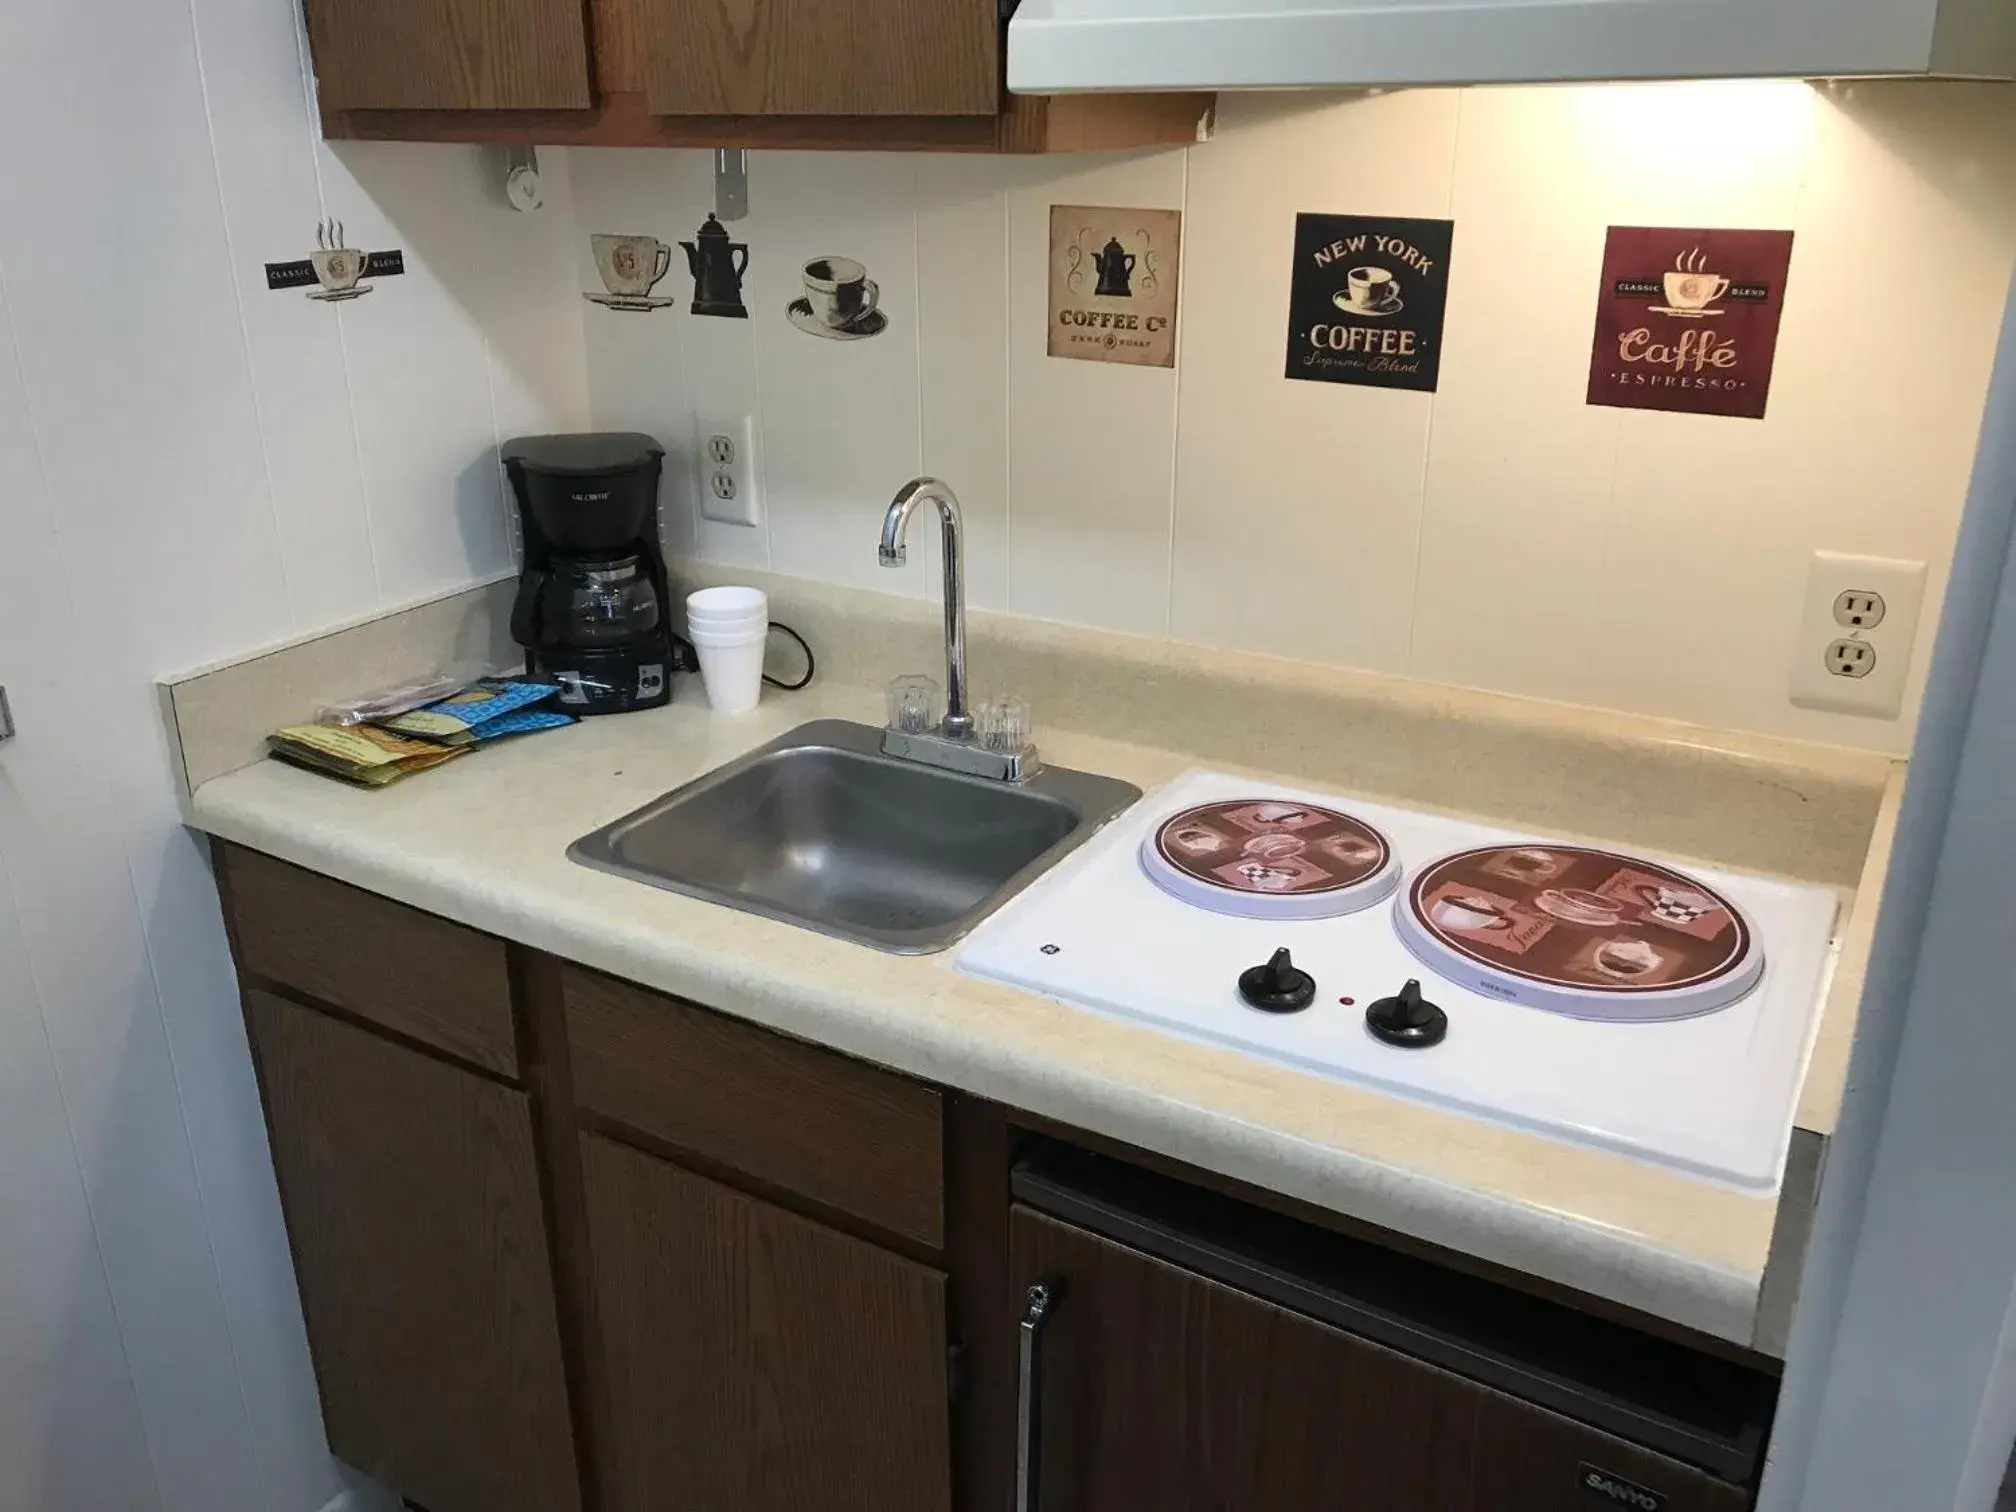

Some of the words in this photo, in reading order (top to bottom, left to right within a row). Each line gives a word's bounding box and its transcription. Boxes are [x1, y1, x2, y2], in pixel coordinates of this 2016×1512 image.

[1313, 235, 1368, 268] NEW
[1374, 235, 1433, 276] YORK
[270, 268, 310, 280] CLASSIC
[1618, 282, 1659, 292] CLASSIC
[1731, 287, 1766, 297] BLEND
[1059, 309, 1139, 331] COFFEE
[1310, 324, 1416, 355] COFFEE
[1618, 328, 1737, 372] Caffé
[1367, 356, 1419, 373] Blend
[1619, 372, 1737, 390] ESPRESSO
[1586, 1472, 1657, 1511] SANYO
